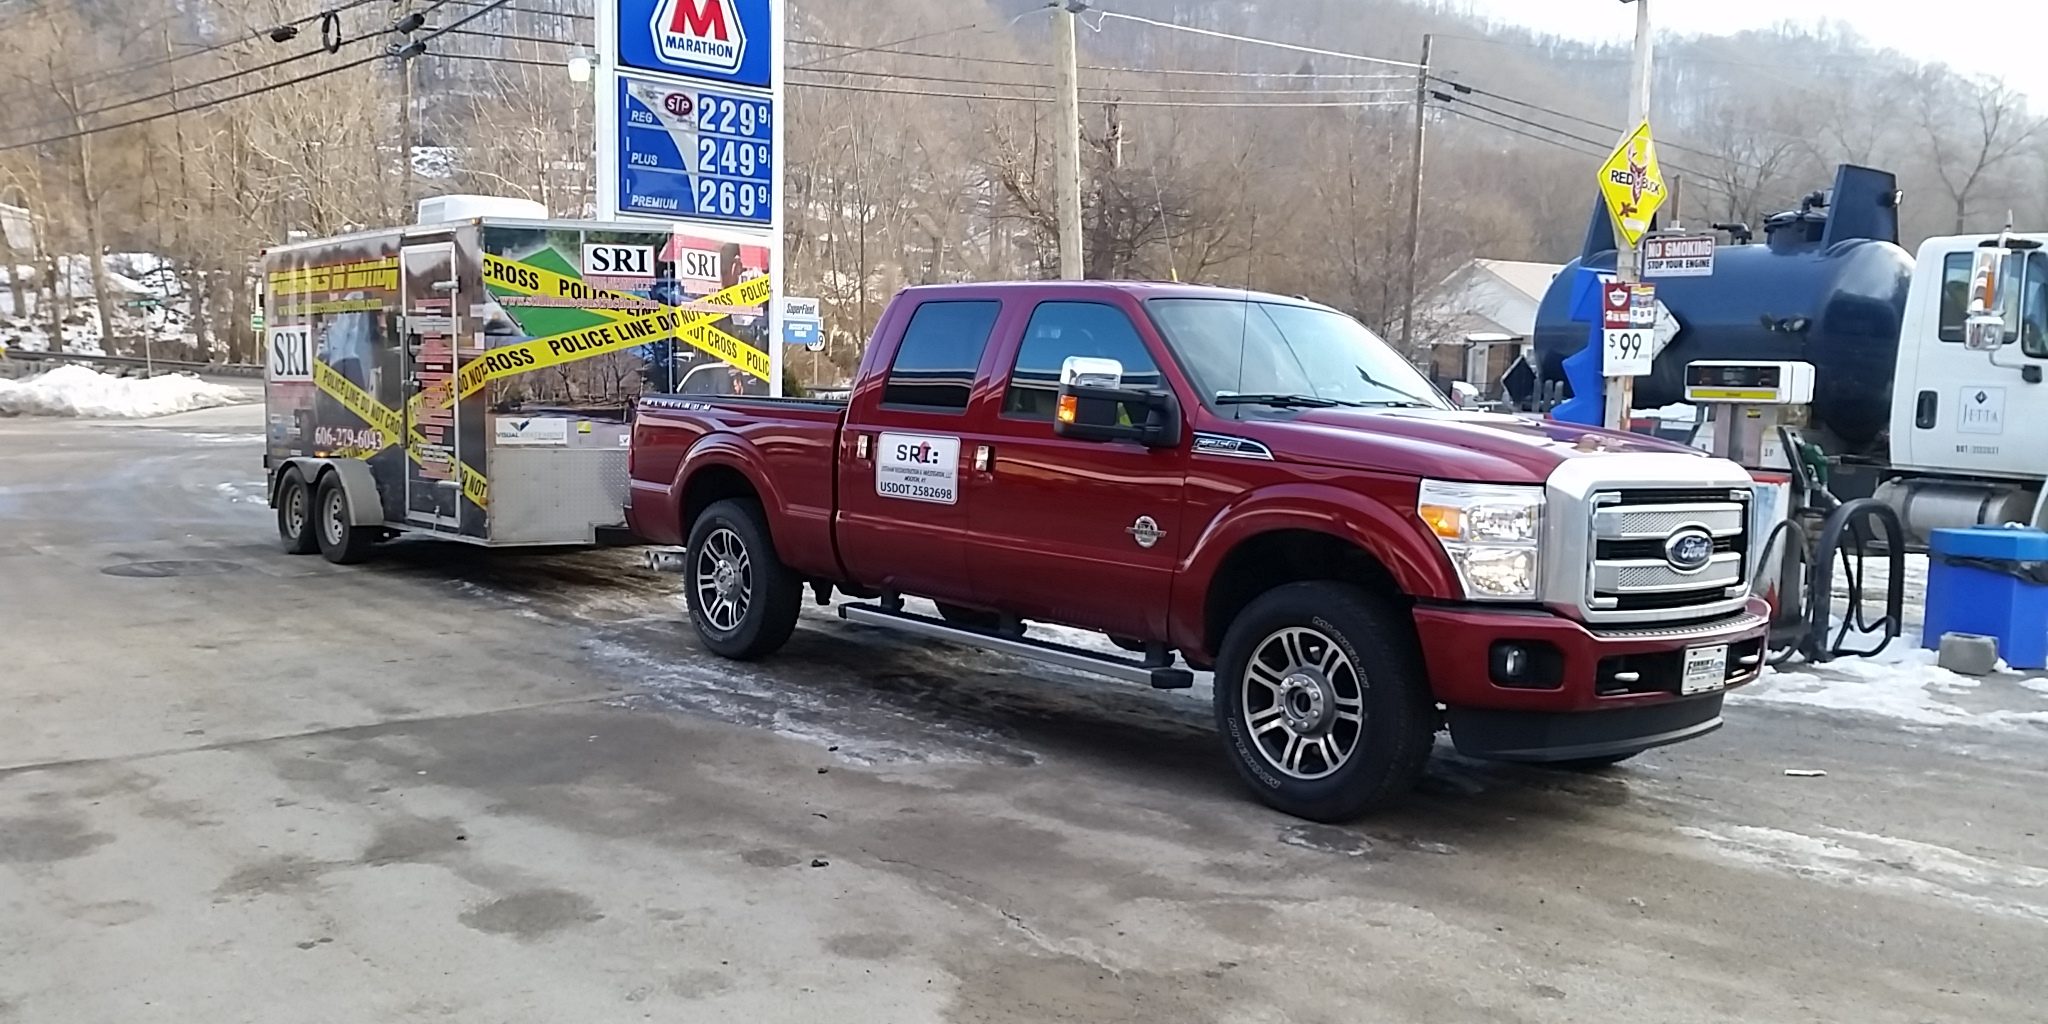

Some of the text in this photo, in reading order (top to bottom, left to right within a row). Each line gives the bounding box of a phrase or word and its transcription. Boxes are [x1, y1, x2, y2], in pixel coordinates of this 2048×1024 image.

[665, 35, 734, 59] MARATHON
[667, 95, 690, 112] STP
[631, 110, 653, 124] REG
[699, 97, 756, 136] 229
[631, 152, 658, 166] PLUS
[699, 138, 755, 177] 249
[1610, 170, 1634, 186] RED
[631, 195, 678, 210] PREMIUM
[699, 180, 755, 216] 269
[592, 247, 648, 273] SRI
[1647, 240, 1712, 258] NO SMOKING
[483, 258, 540, 291] CROSS
[686, 252, 717, 278] SRI
[1647, 259, 1710, 270] STOP YOUR ENGINE
[547, 328, 615, 357] POLICE
[614, 317, 657, 341] LINE
[707, 329, 738, 359] CROSS
[274, 332, 310, 376] SRI
[1963, 403, 1999, 424] JETTA
[314, 426, 383, 450] 606-279-6043
[880, 481, 952, 500] USDOT 2582698
[1681, 536, 1708, 559] Ford
